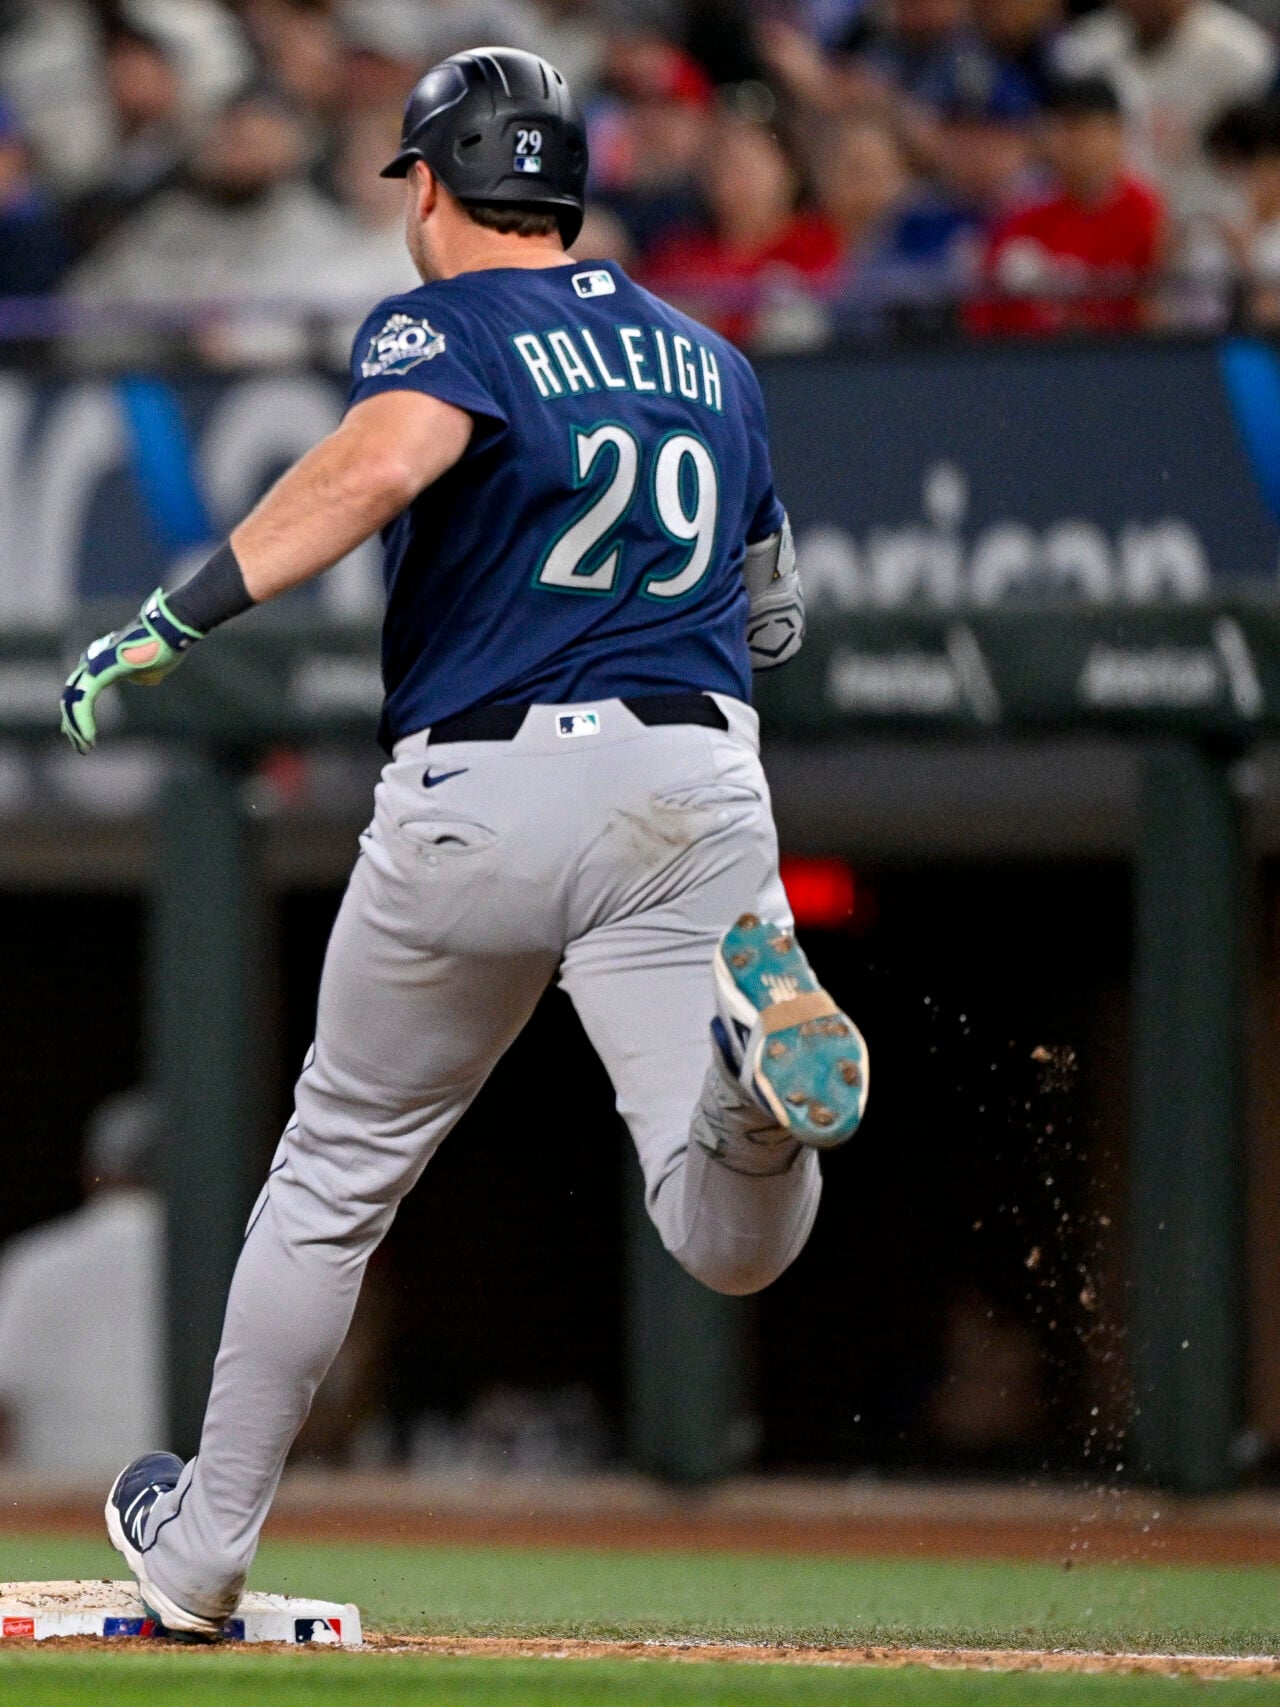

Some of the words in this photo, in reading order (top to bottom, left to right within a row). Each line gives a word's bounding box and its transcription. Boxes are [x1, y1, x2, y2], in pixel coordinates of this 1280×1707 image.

[516, 129, 542, 155] 29
[377, 326, 427, 363] 50
[511, 326, 723, 414] RALEIGH
[533, 420, 720, 603] 29
